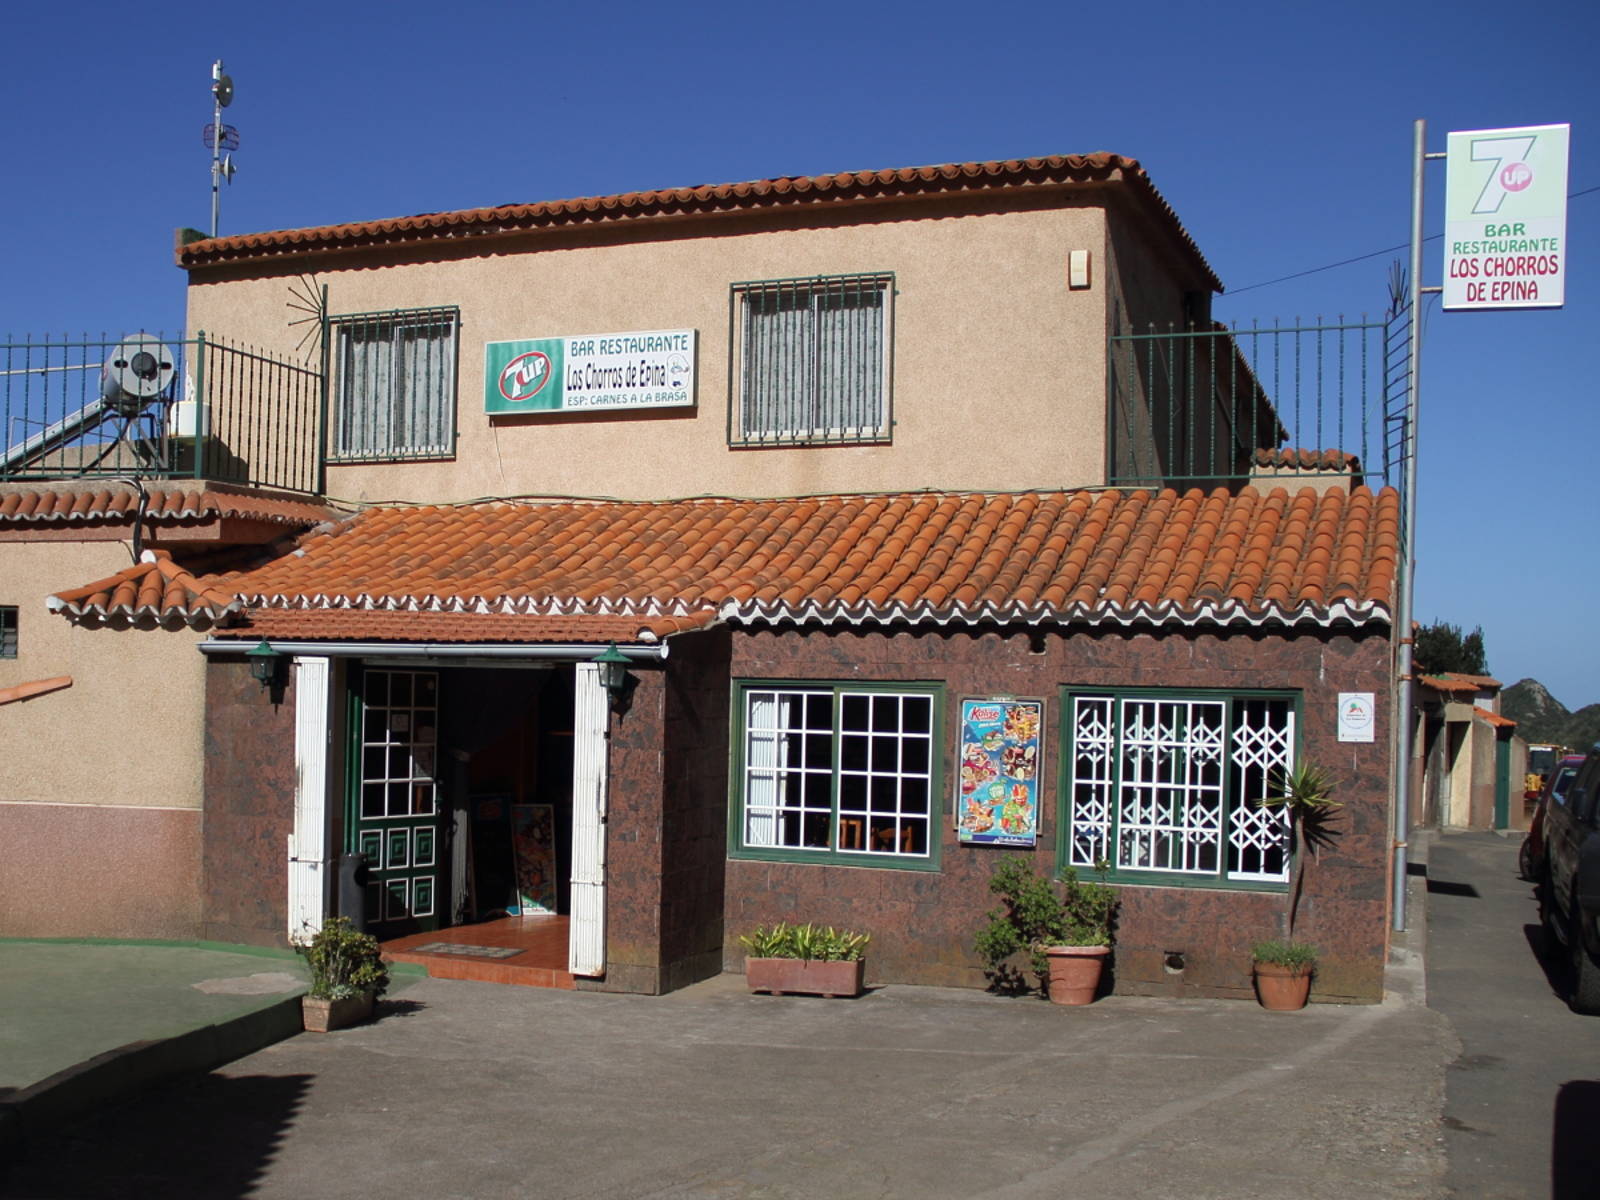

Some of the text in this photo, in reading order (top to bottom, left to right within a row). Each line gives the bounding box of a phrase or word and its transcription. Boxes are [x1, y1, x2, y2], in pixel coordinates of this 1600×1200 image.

[1484, 223, 1526, 238] BAR
[1453, 238, 1558, 255] RESTAURANTE
[1450, 254, 1559, 278] LOS CHORROS
[1467, 280, 1538, 302] DE EPINA
[571, 334, 688, 357] BAR RESTAURANTE
[567, 359, 665, 391] Los Chorros de Epina
[567, 391, 687, 406] ESP: CARNES A LA BRASA
